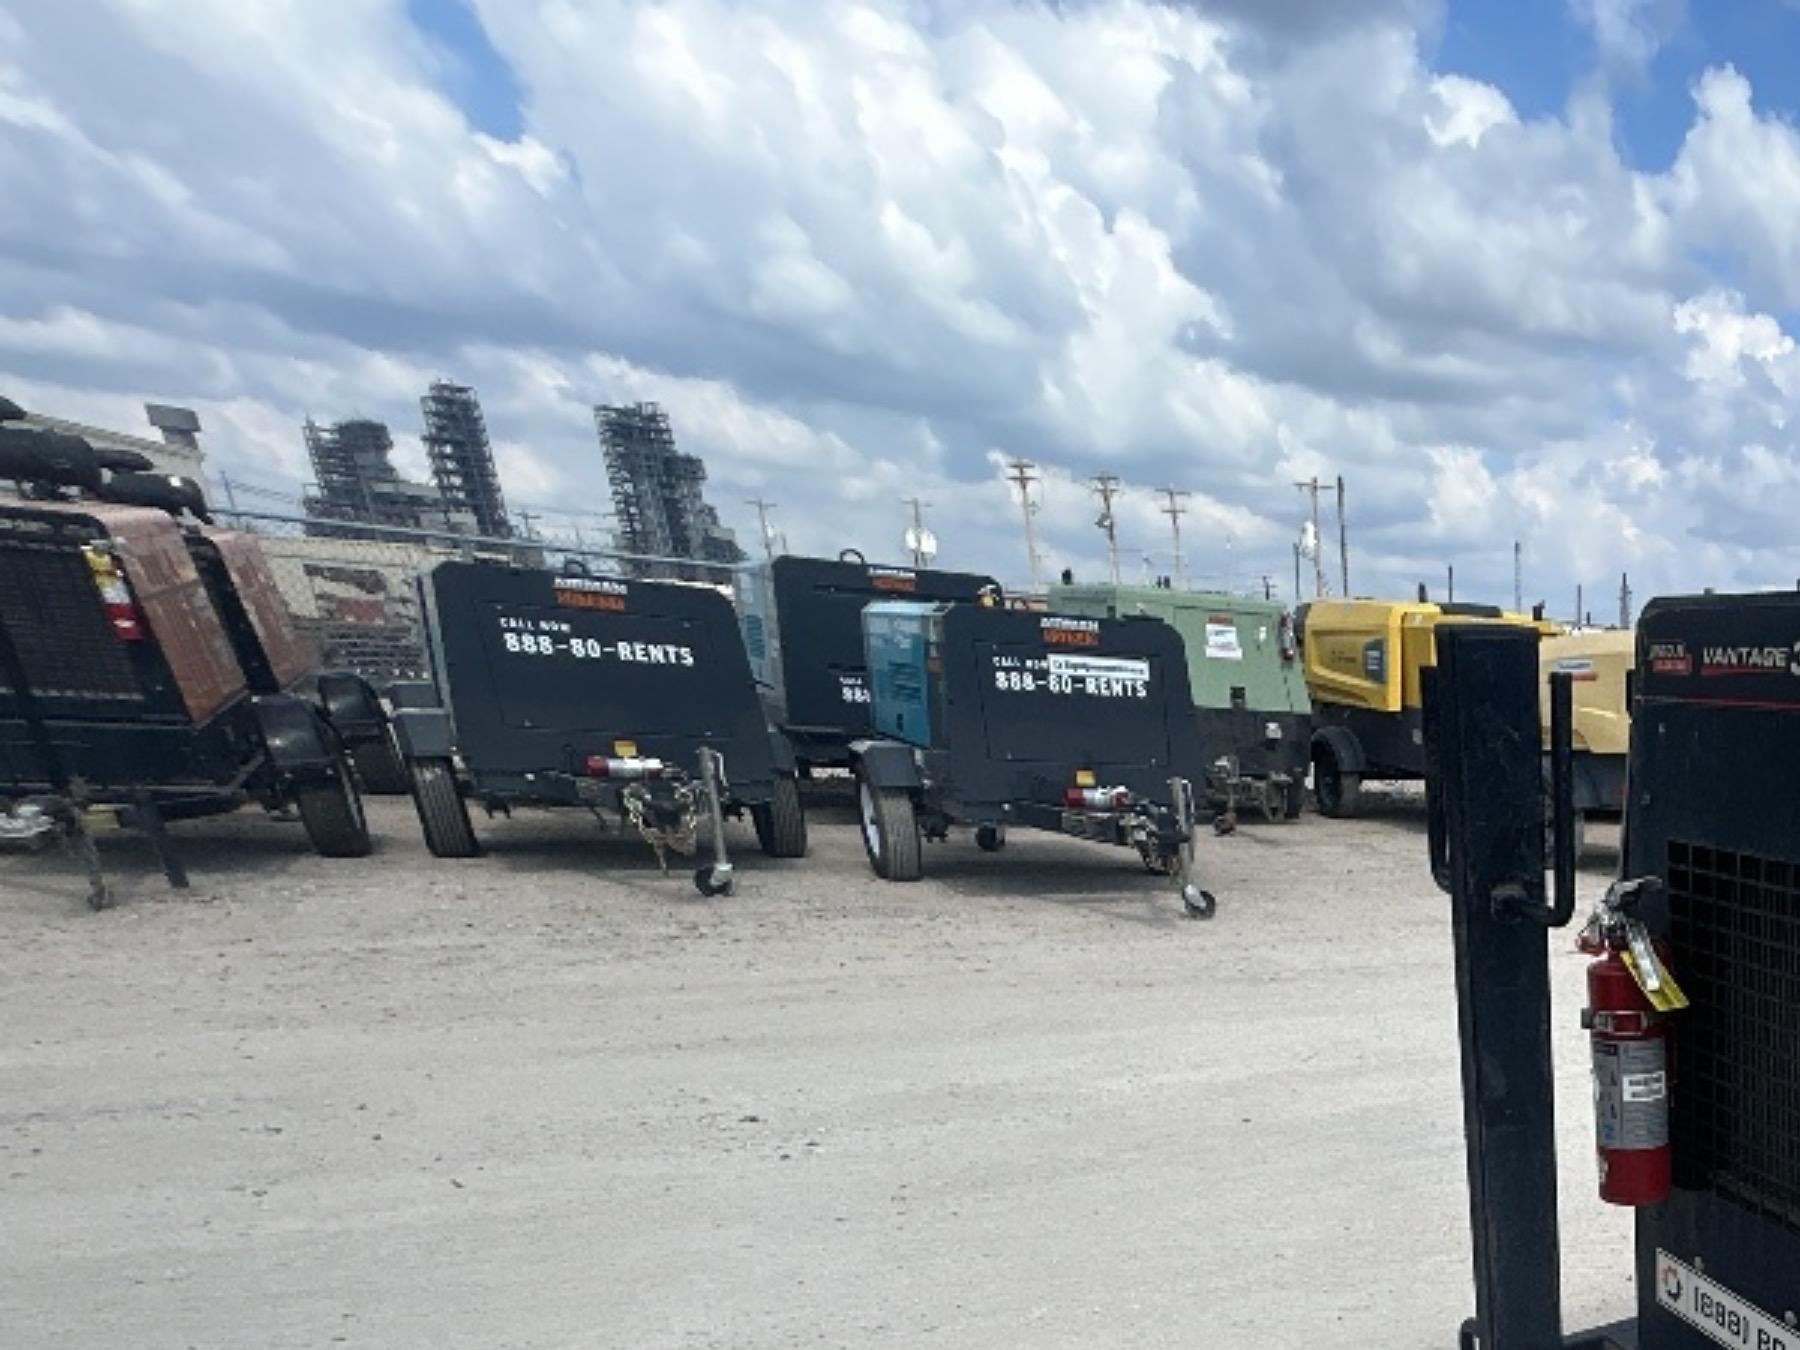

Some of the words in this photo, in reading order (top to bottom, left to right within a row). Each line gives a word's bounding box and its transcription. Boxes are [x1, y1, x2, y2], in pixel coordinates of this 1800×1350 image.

[503, 632, 694, 666] 888-80-RENTS
[1702, 646, 1790, 667] VANTAGE
[1694, 1285, 1750, 1345] (888)
